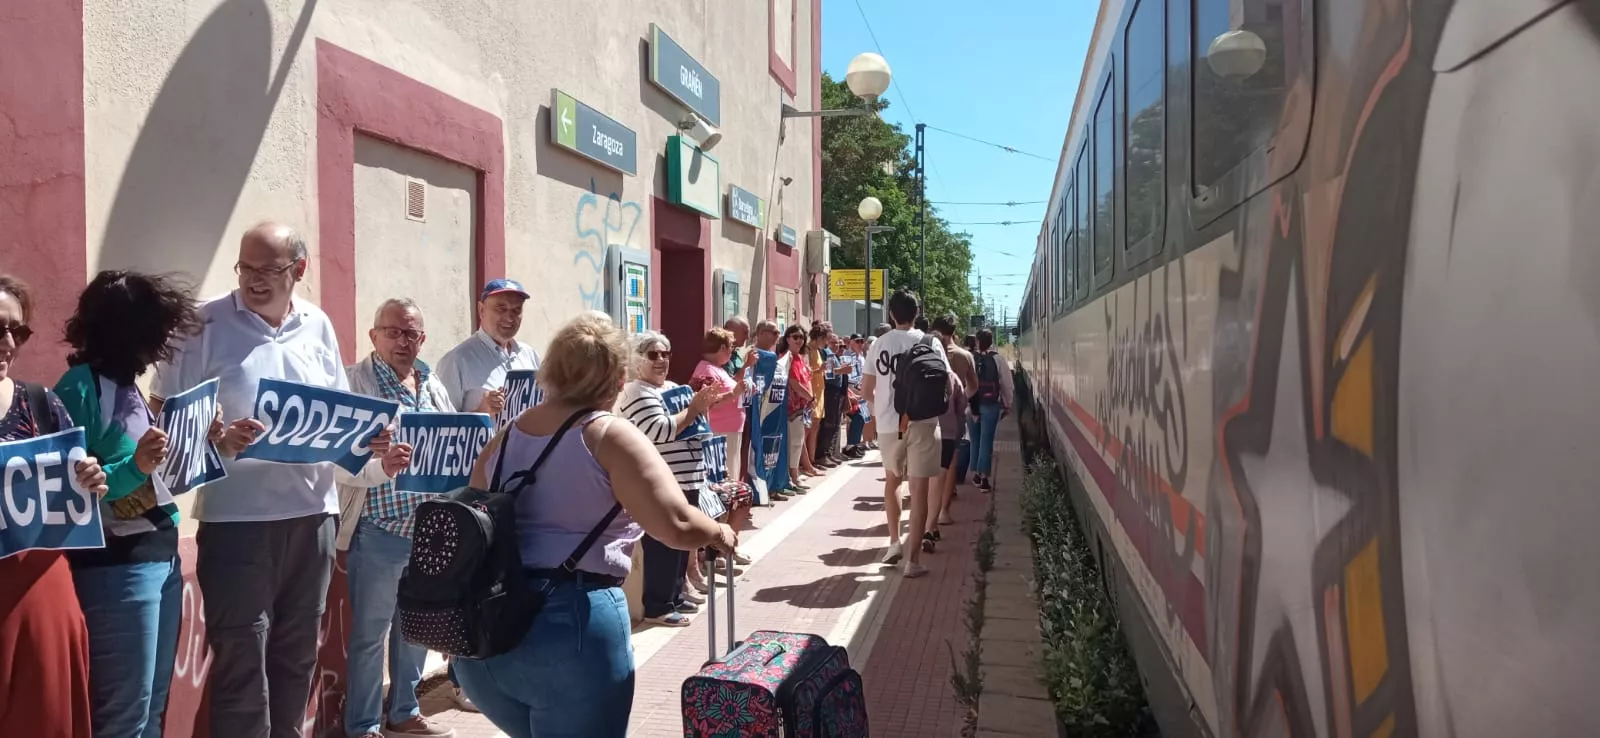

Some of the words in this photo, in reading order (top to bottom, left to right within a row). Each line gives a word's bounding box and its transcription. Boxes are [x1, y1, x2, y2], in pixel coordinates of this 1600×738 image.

[680, 64, 703, 101] GRAÑÉN
[592, 124, 623, 157] Zaragoza
[248, 390, 390, 457] SODETO
[398, 426, 494, 477] MONTESUS
[0, 446, 92, 530] CES
